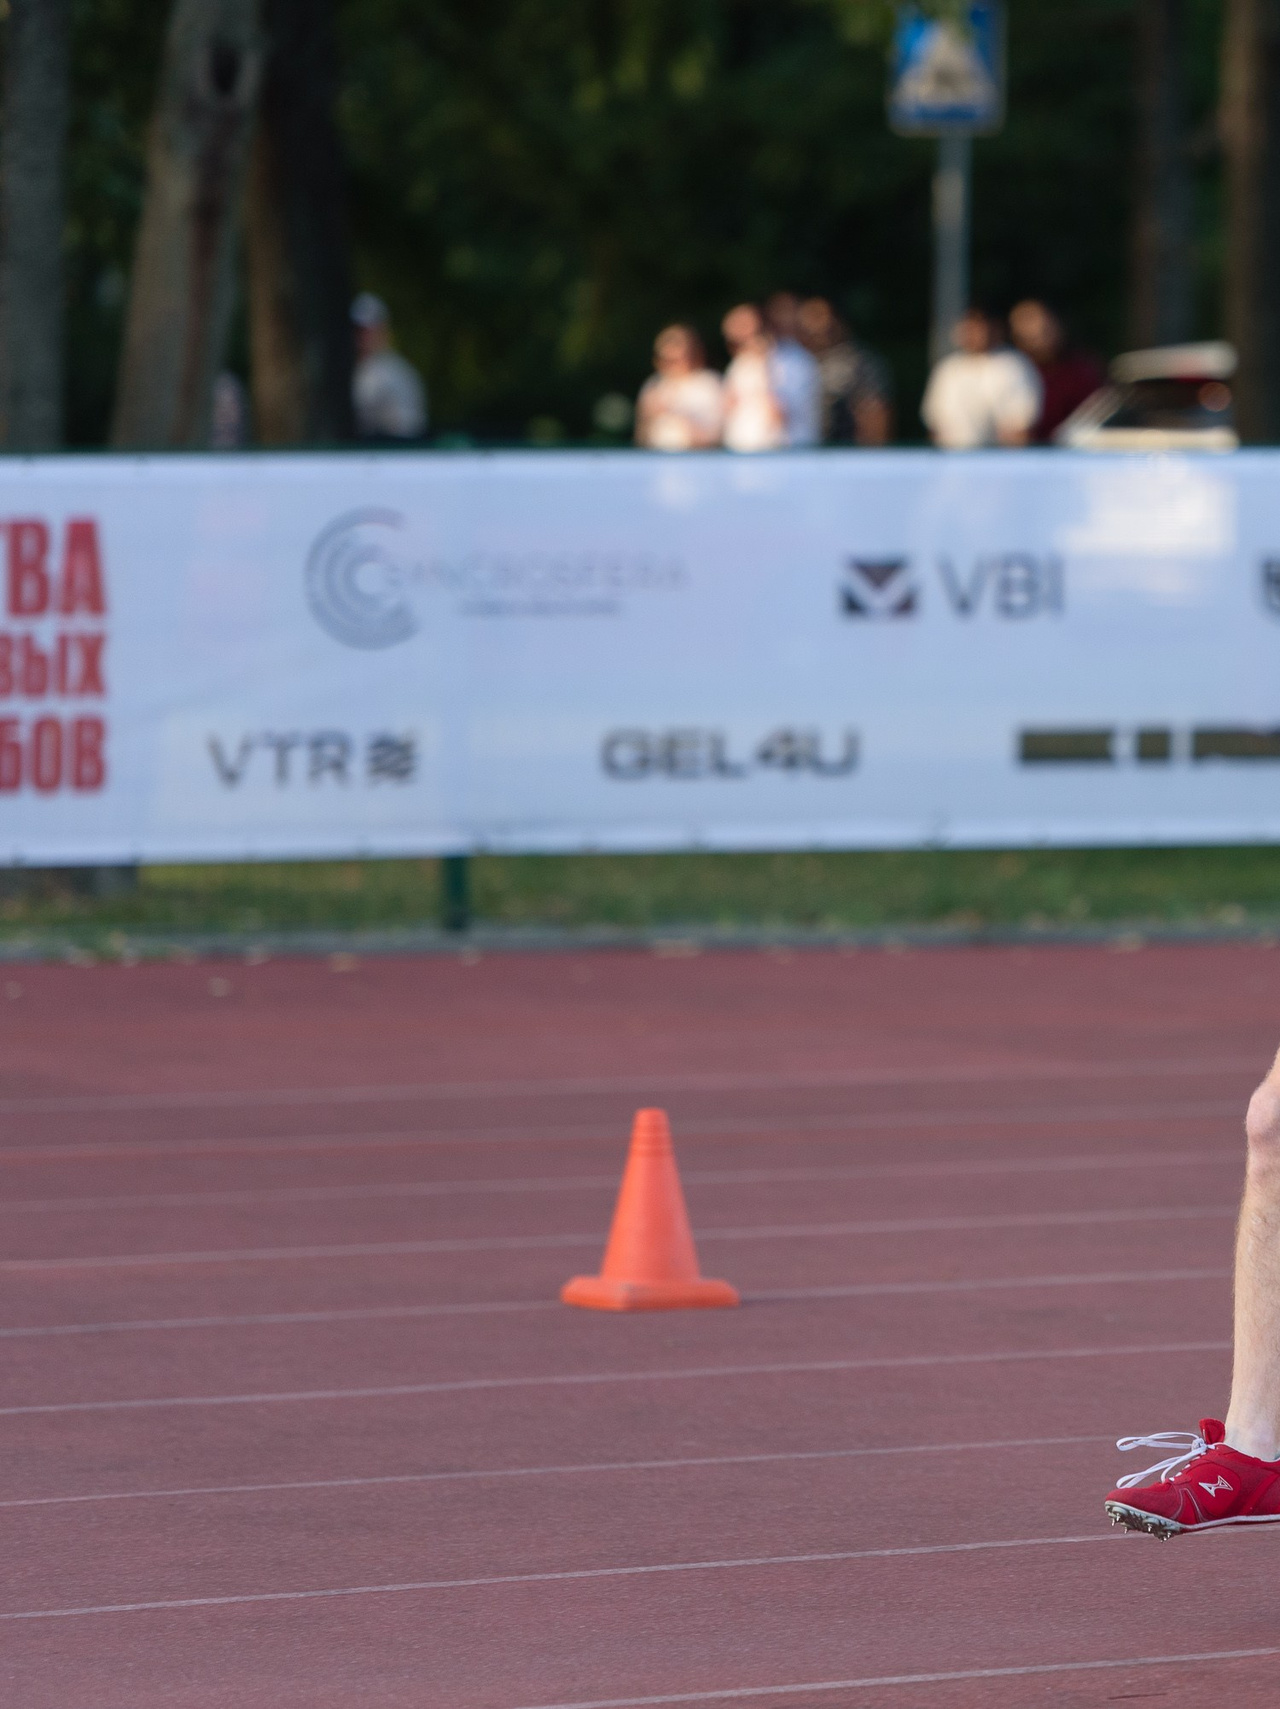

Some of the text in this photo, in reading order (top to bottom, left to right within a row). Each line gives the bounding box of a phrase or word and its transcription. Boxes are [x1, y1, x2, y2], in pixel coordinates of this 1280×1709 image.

[0, 519, 106, 616] ВА
[937, 557, 1065, 617] VBI
[207, 732, 354, 788] VTR
[603, 730, 860, 780] GEL4U
